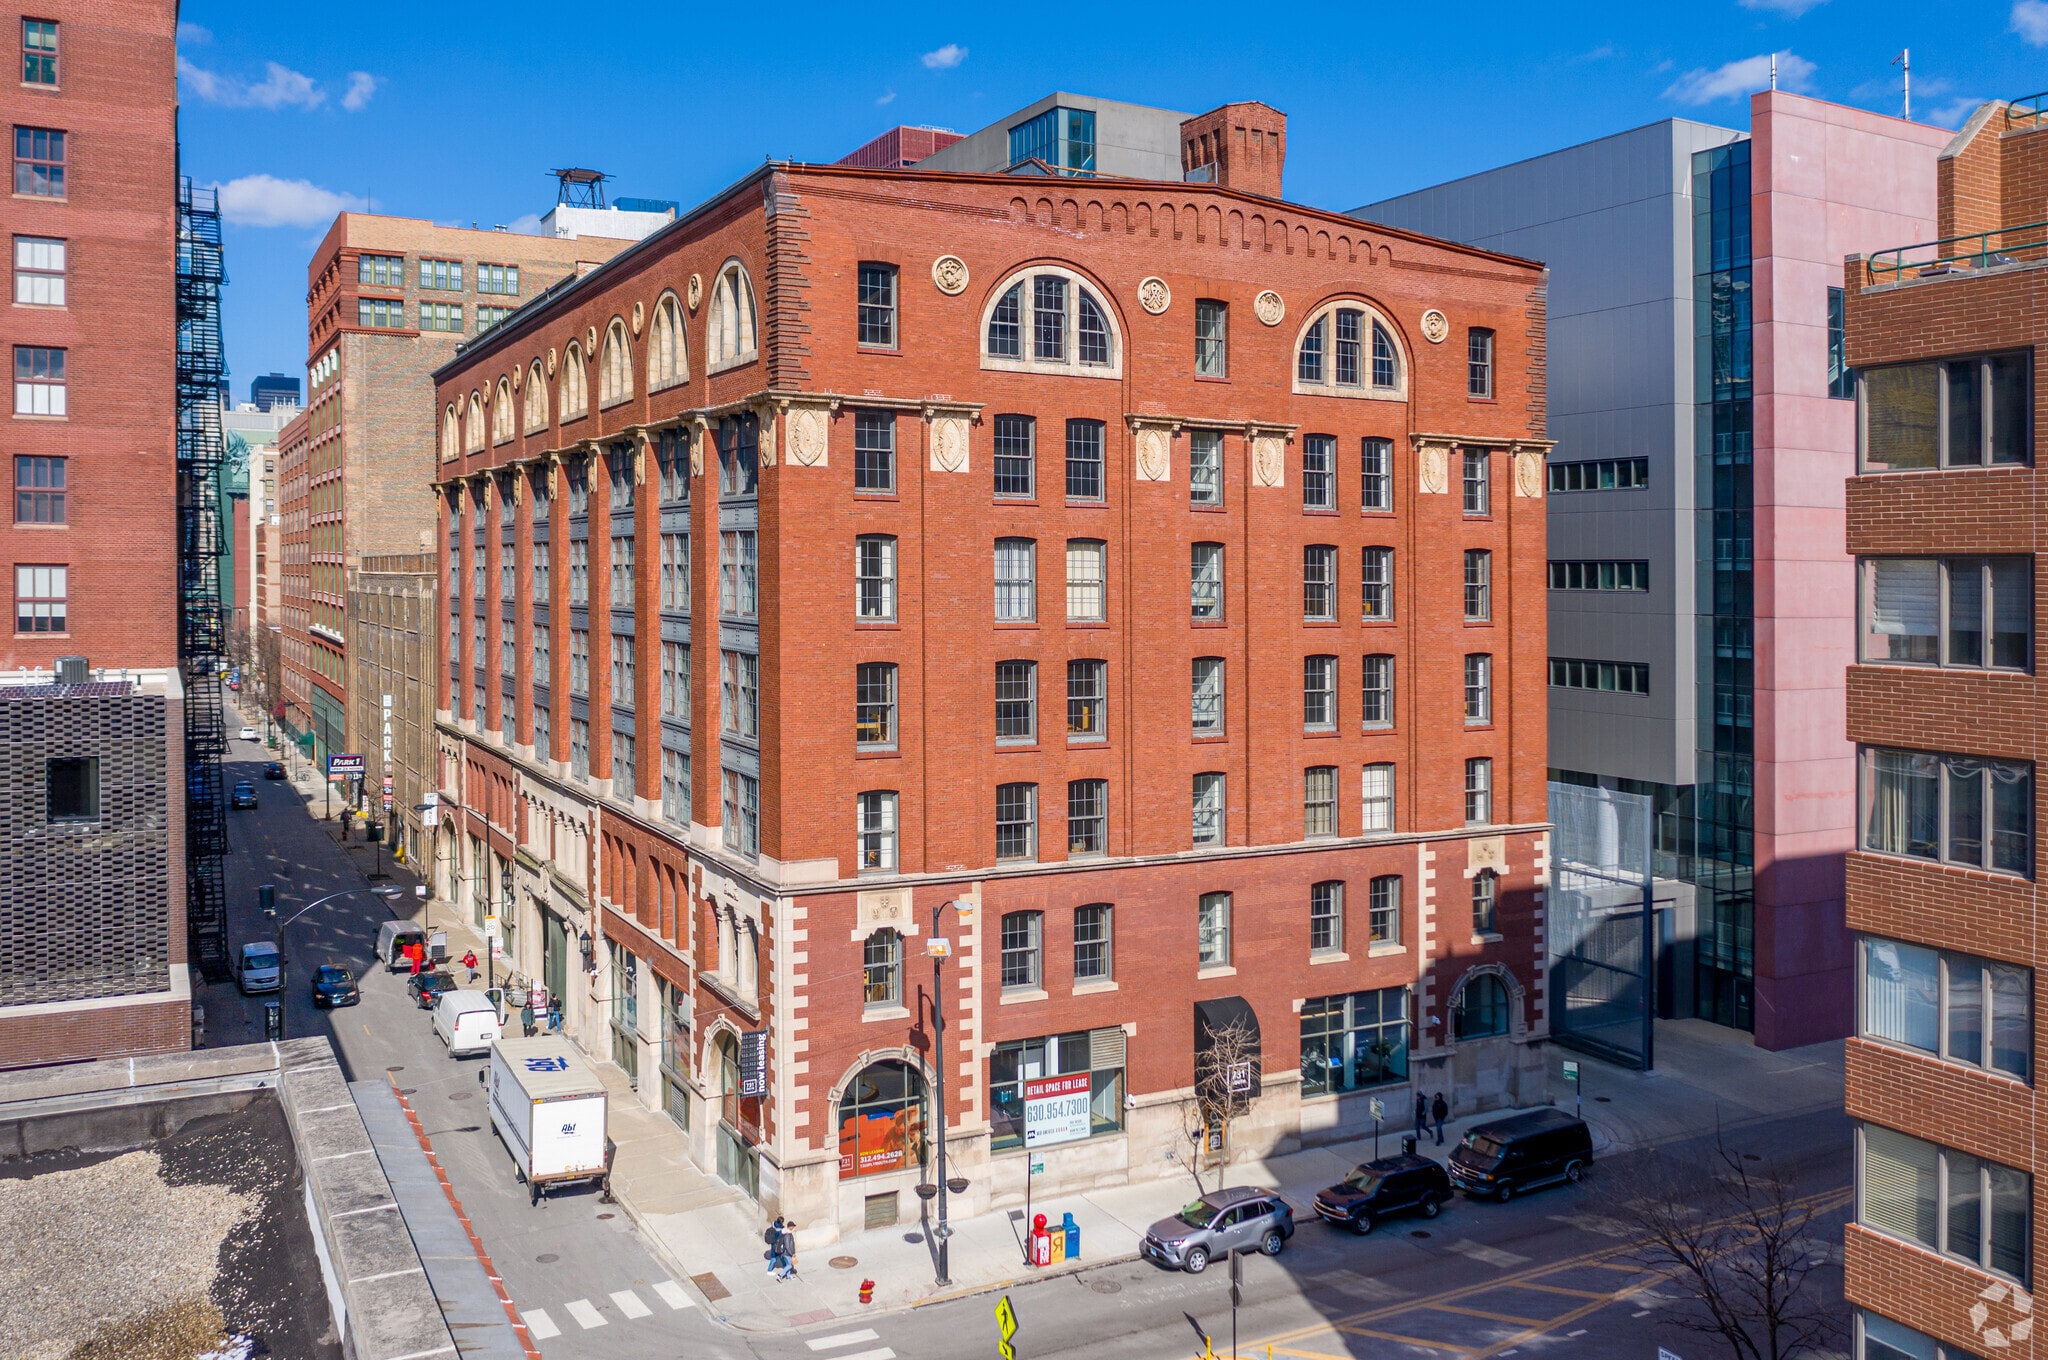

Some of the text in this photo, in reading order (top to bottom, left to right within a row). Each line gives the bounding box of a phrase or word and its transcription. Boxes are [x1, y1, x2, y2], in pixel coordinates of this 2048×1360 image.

[383, 708, 392, 762] PARK
[333, 758, 355, 766] PARK
[757, 1034, 767, 1093] now leasing
[1027, 1077, 1088, 1096] RETAIL SPACE FOR LEASE
[1027, 1097, 1088, 1123] 630.954.7300
[561, 1123, 576, 1133] Abt
